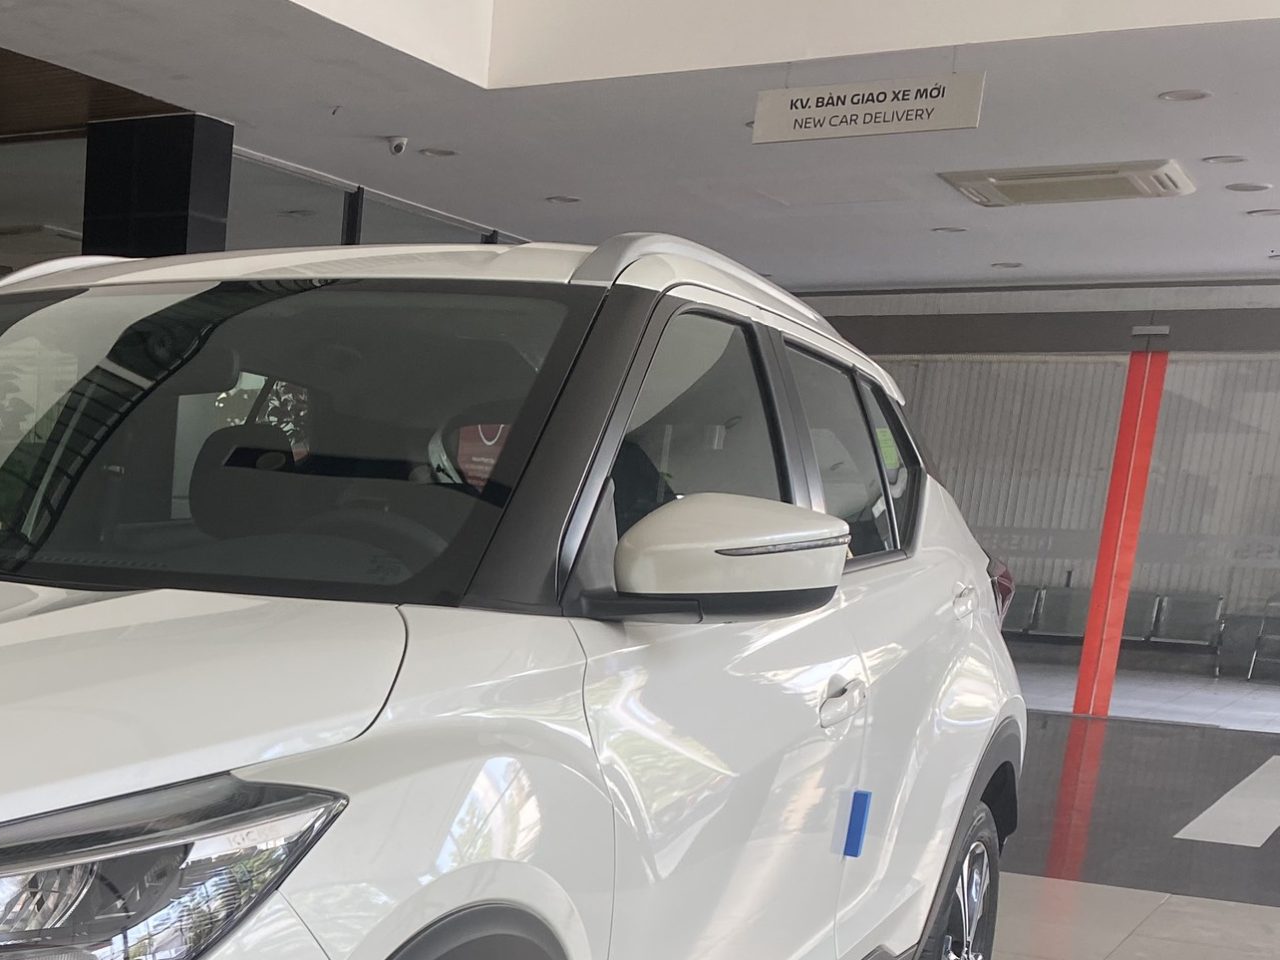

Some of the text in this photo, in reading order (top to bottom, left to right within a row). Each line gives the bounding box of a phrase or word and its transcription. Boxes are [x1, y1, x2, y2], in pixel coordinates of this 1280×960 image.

[789, 83, 947, 111] KV. BÀN GIAO XE MỚI
[792, 107, 936, 130] NEW CAR DELIVERY
